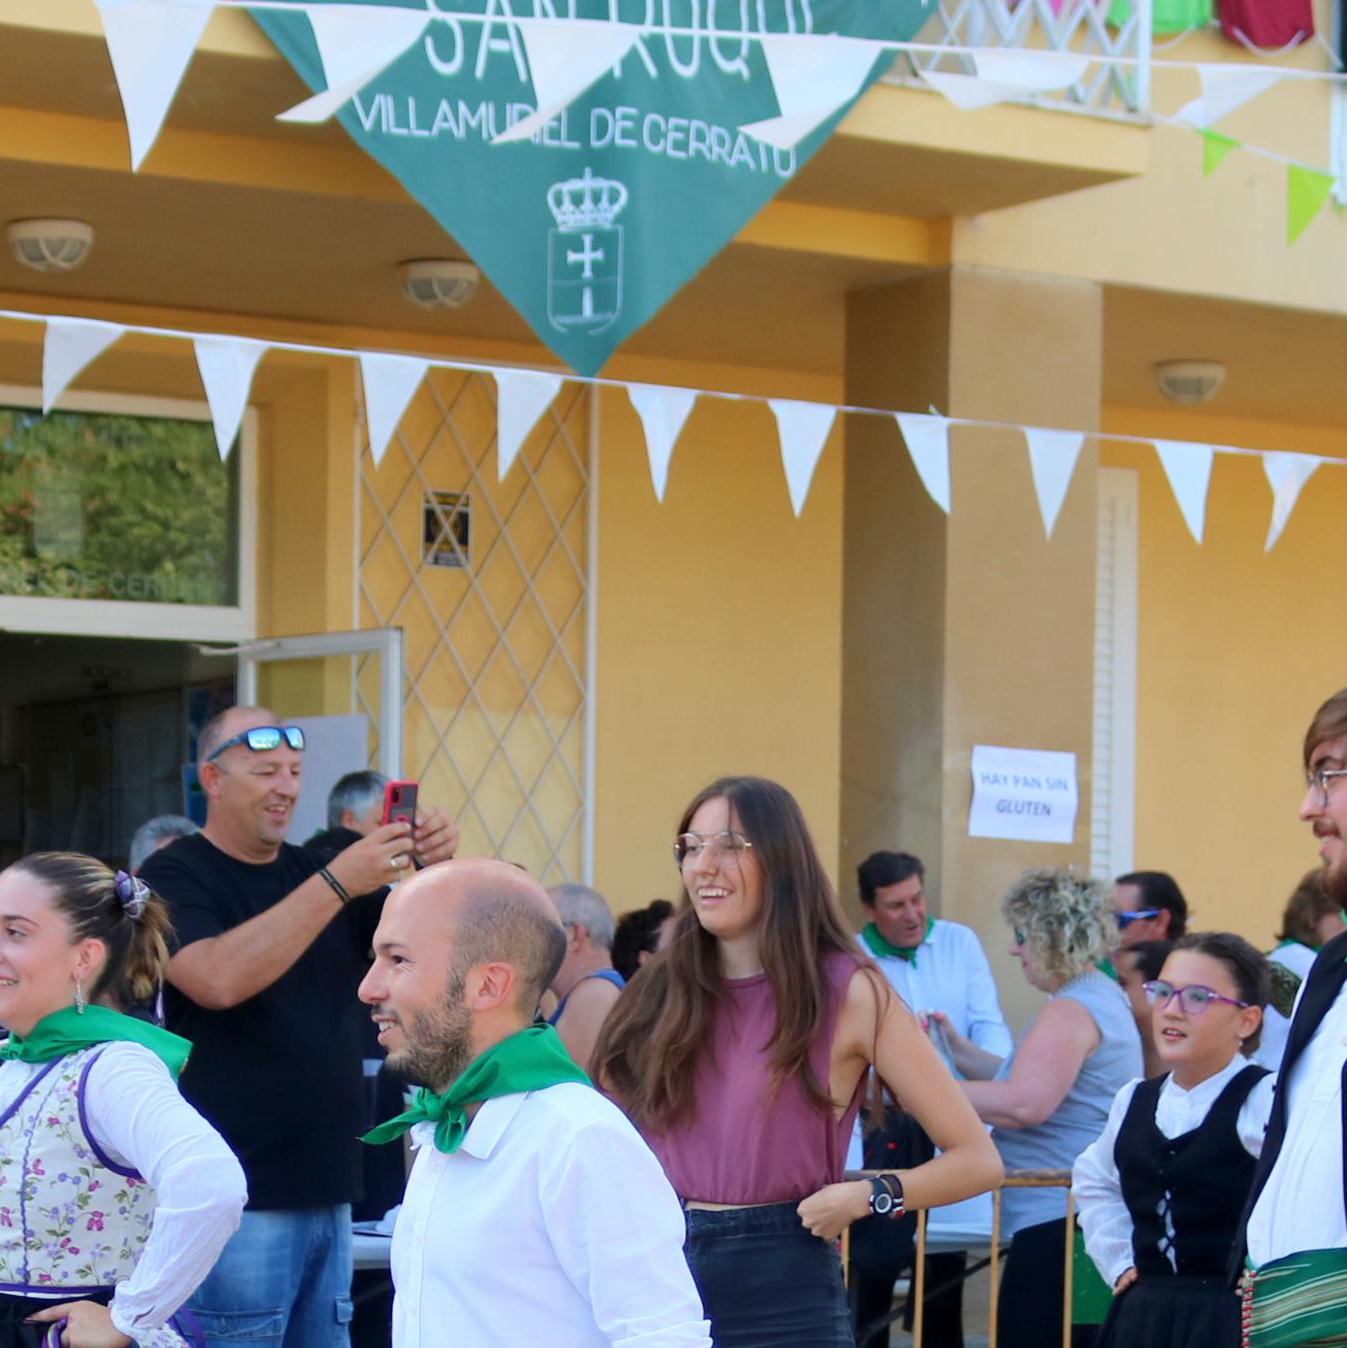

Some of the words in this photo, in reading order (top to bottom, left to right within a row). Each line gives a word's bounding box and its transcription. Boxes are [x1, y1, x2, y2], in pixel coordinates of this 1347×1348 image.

[590, 106, 639, 148] DE
[979, 771, 1008, 787] HAY
[1012, 774, 1043, 790] PAN
[1046, 777, 1069, 792] SIN
[995, 799, 1052, 817] GLUTEN
